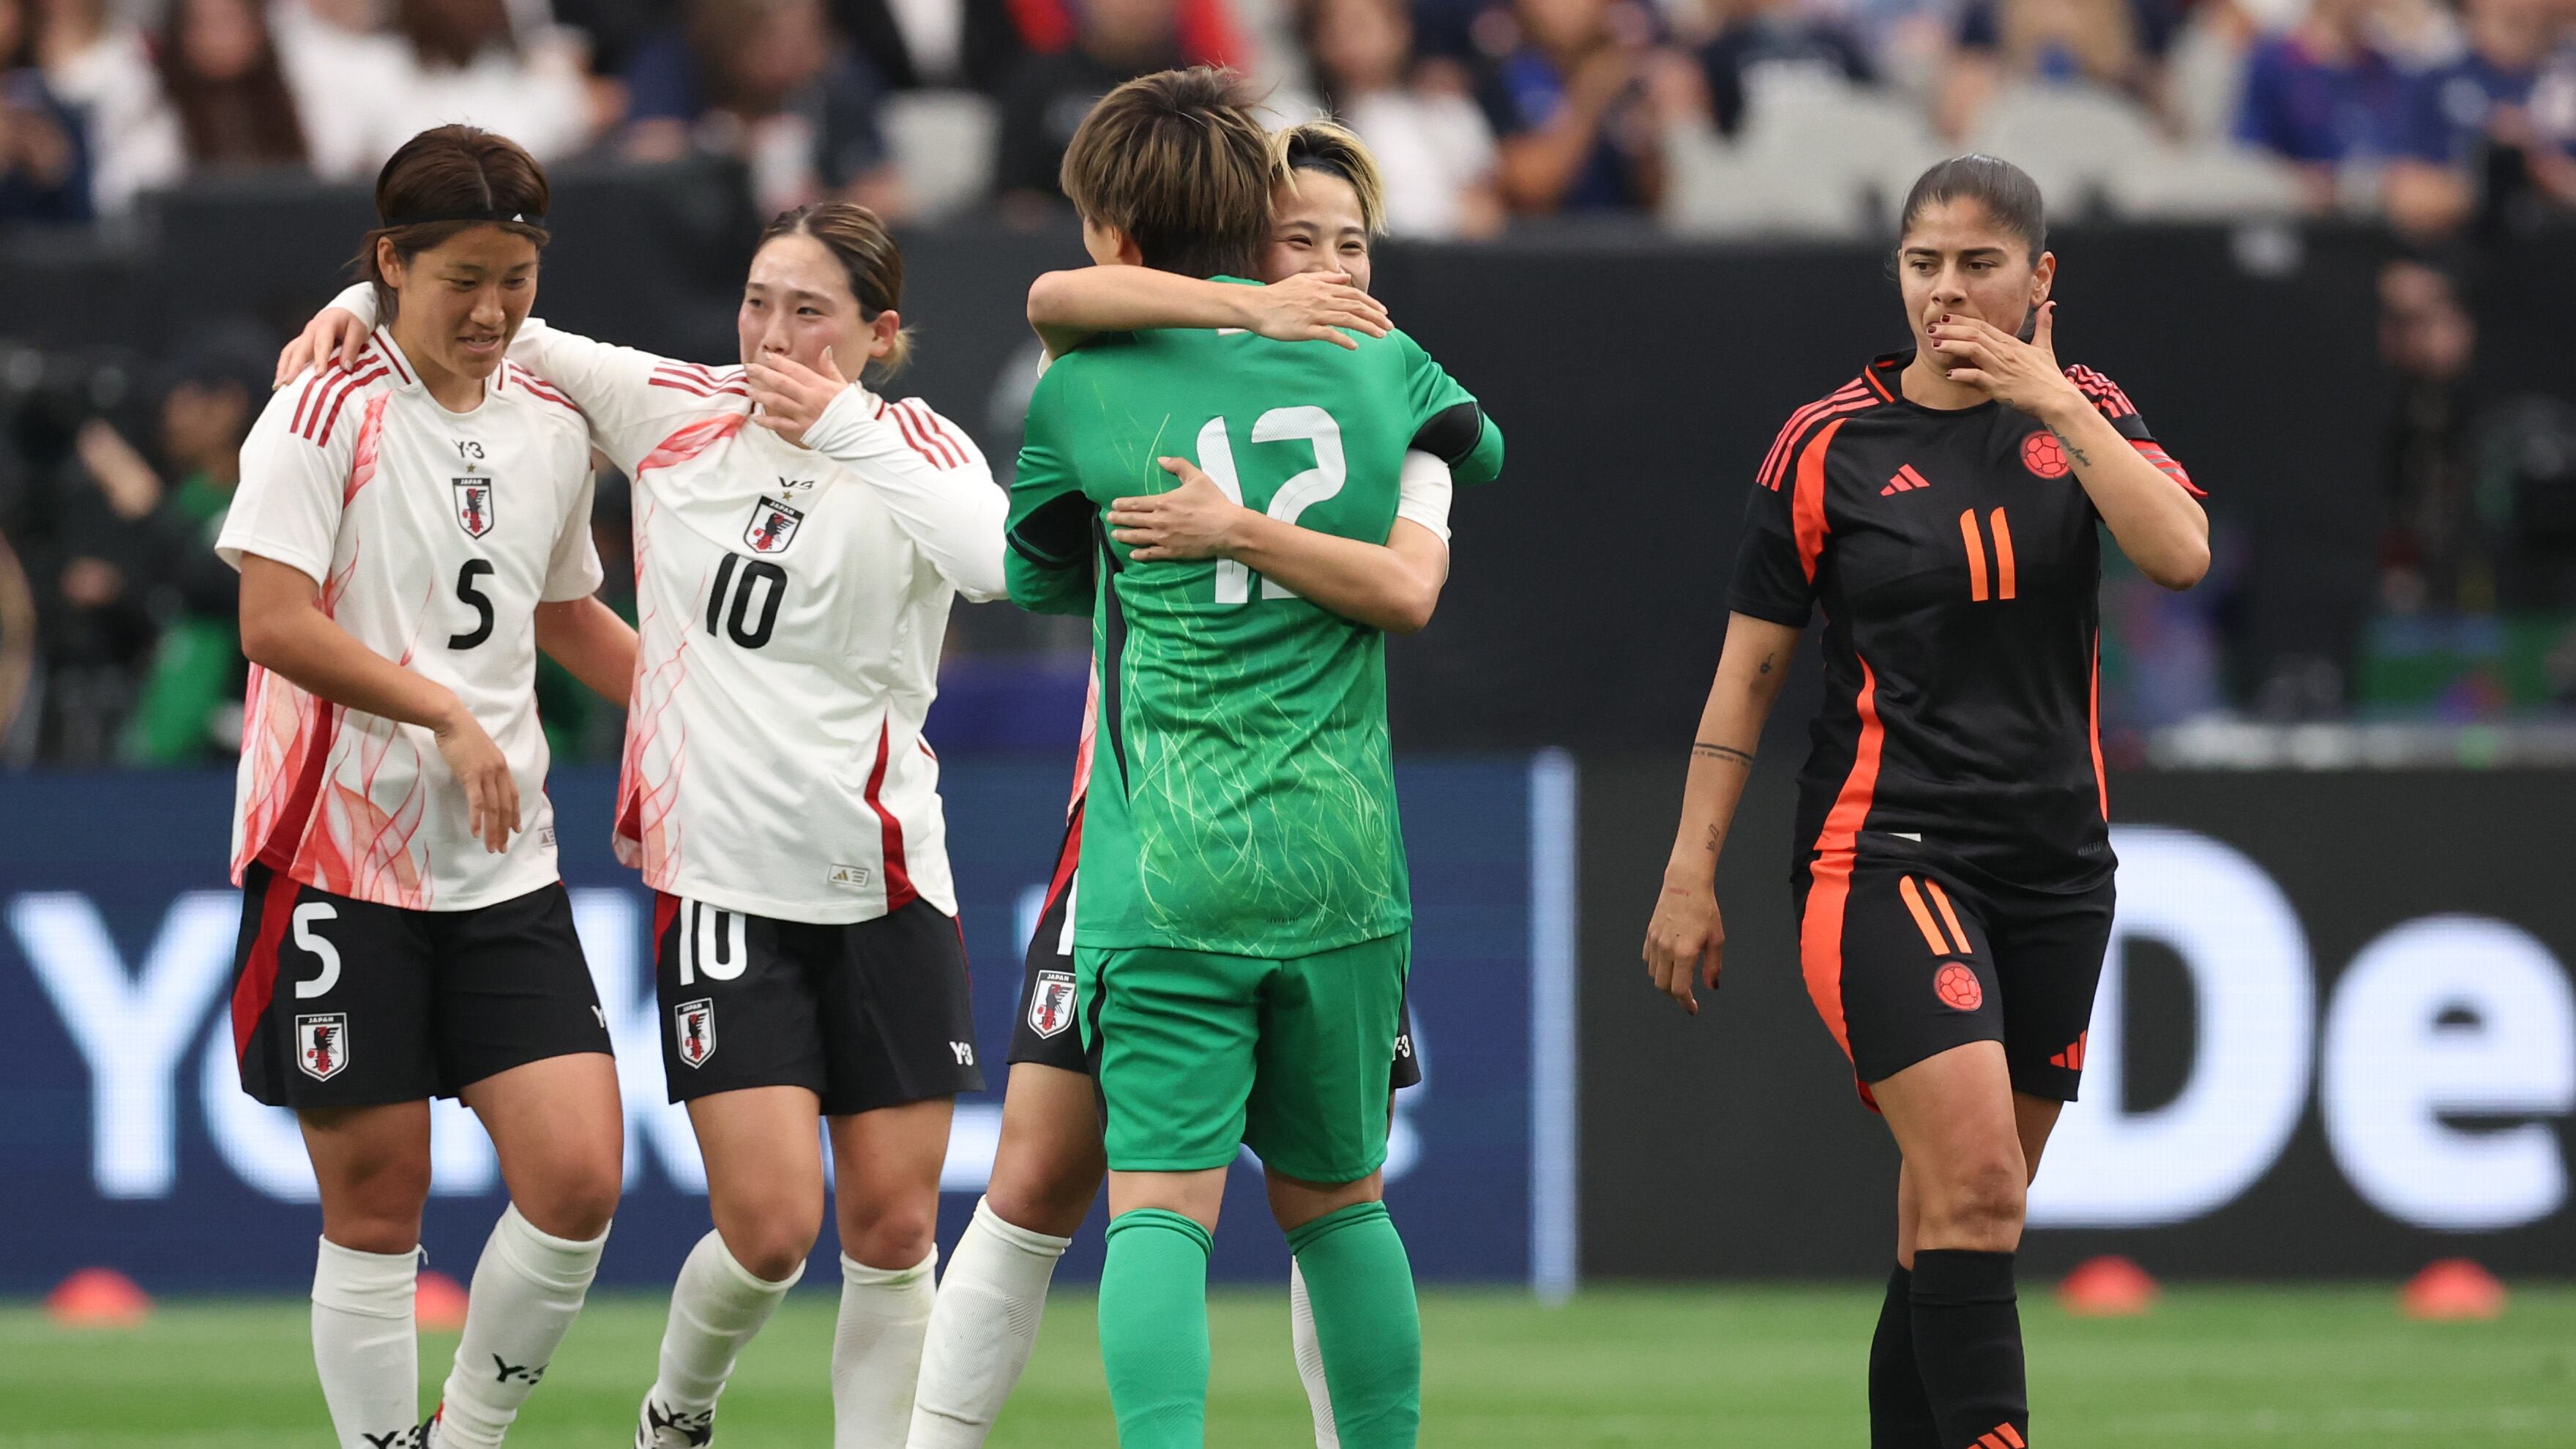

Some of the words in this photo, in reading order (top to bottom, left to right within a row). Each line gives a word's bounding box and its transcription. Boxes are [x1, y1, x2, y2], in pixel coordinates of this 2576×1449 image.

[769, 501, 796, 515] JAPAN
[1196, 405, 1347, 604] 12
[1959, 506, 2016, 602] 11
[447, 558, 495, 650] 5
[706, 551, 788, 649] 10
[293, 901, 343, 999] 5
[679, 896, 748, 986] 10
[1899, 874, 1973, 956] 11
[307, 1016, 335, 1024] JAPAN
[1046, 972, 1070, 982] JAPAN
[948, 1040, 974, 1067] Y-3
